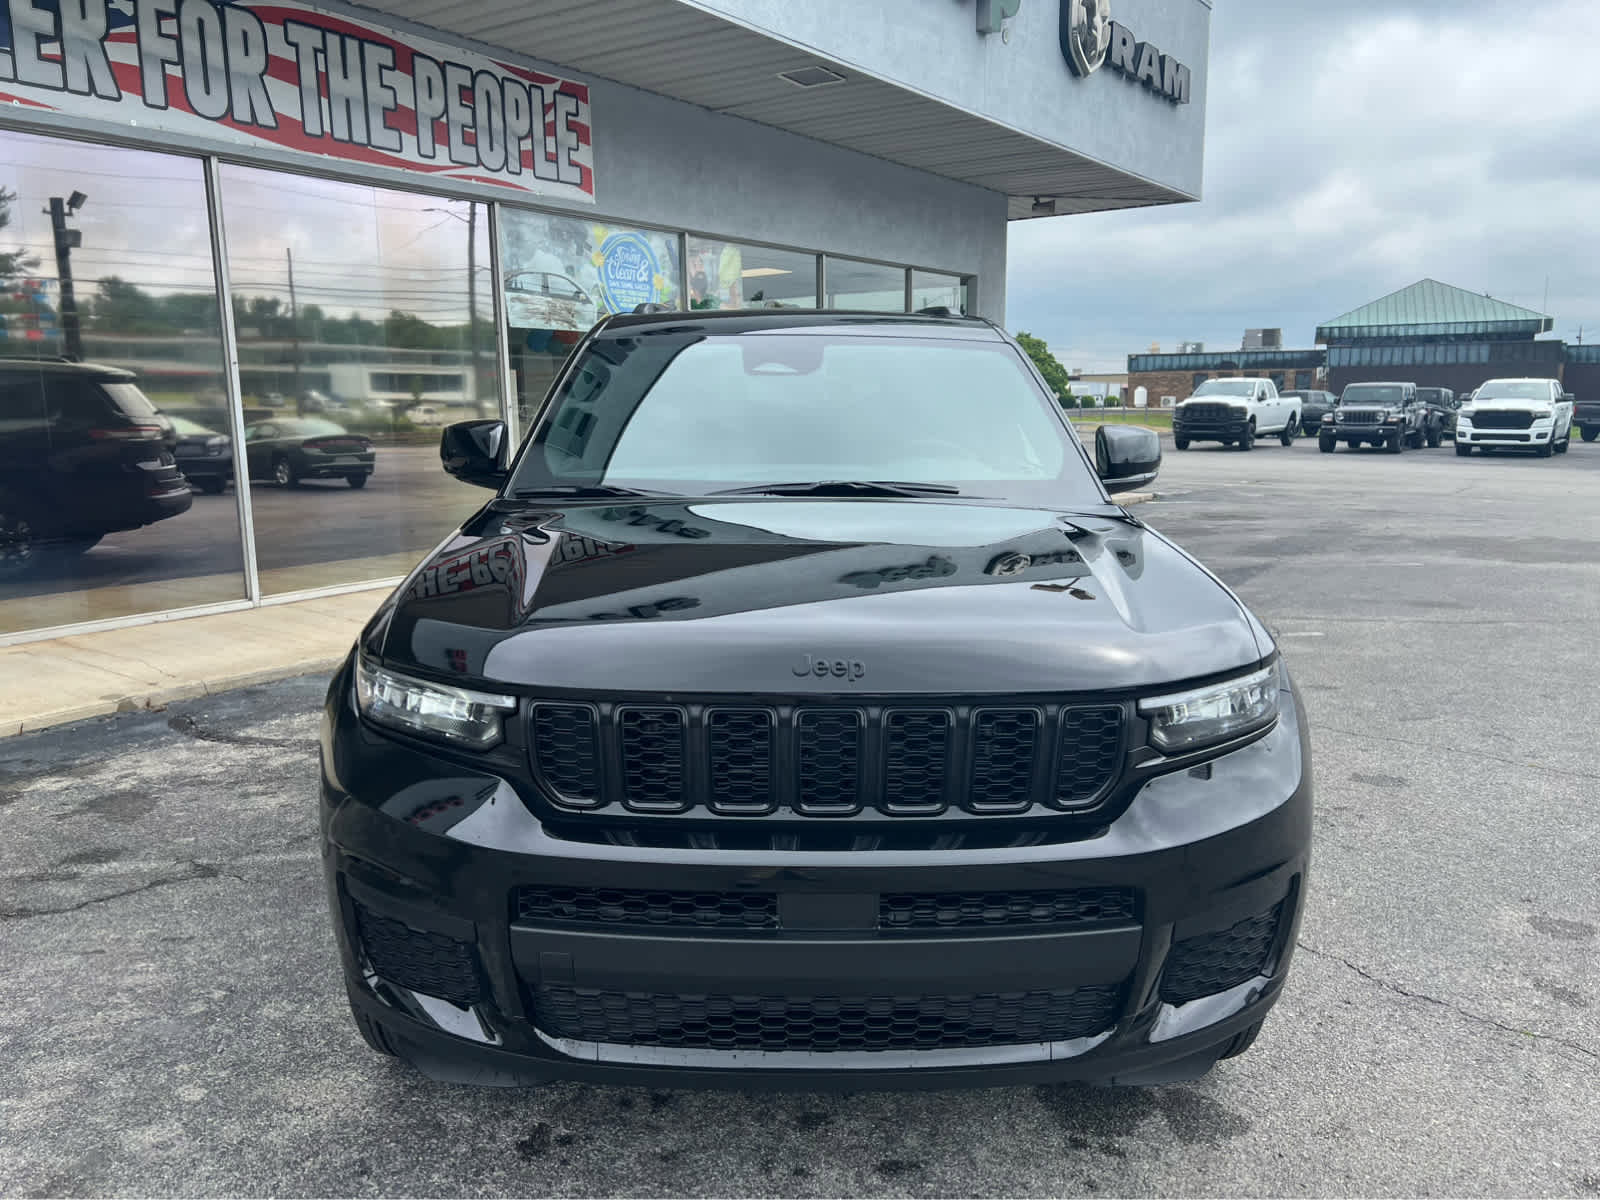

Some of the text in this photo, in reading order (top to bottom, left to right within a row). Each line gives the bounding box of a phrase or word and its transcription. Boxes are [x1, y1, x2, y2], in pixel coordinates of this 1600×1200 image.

[0, 0, 584, 186] ER FOR THE PEOPLE
[1110, 20, 1191, 104] RAM
[791, 653, 865, 682] Jeep
